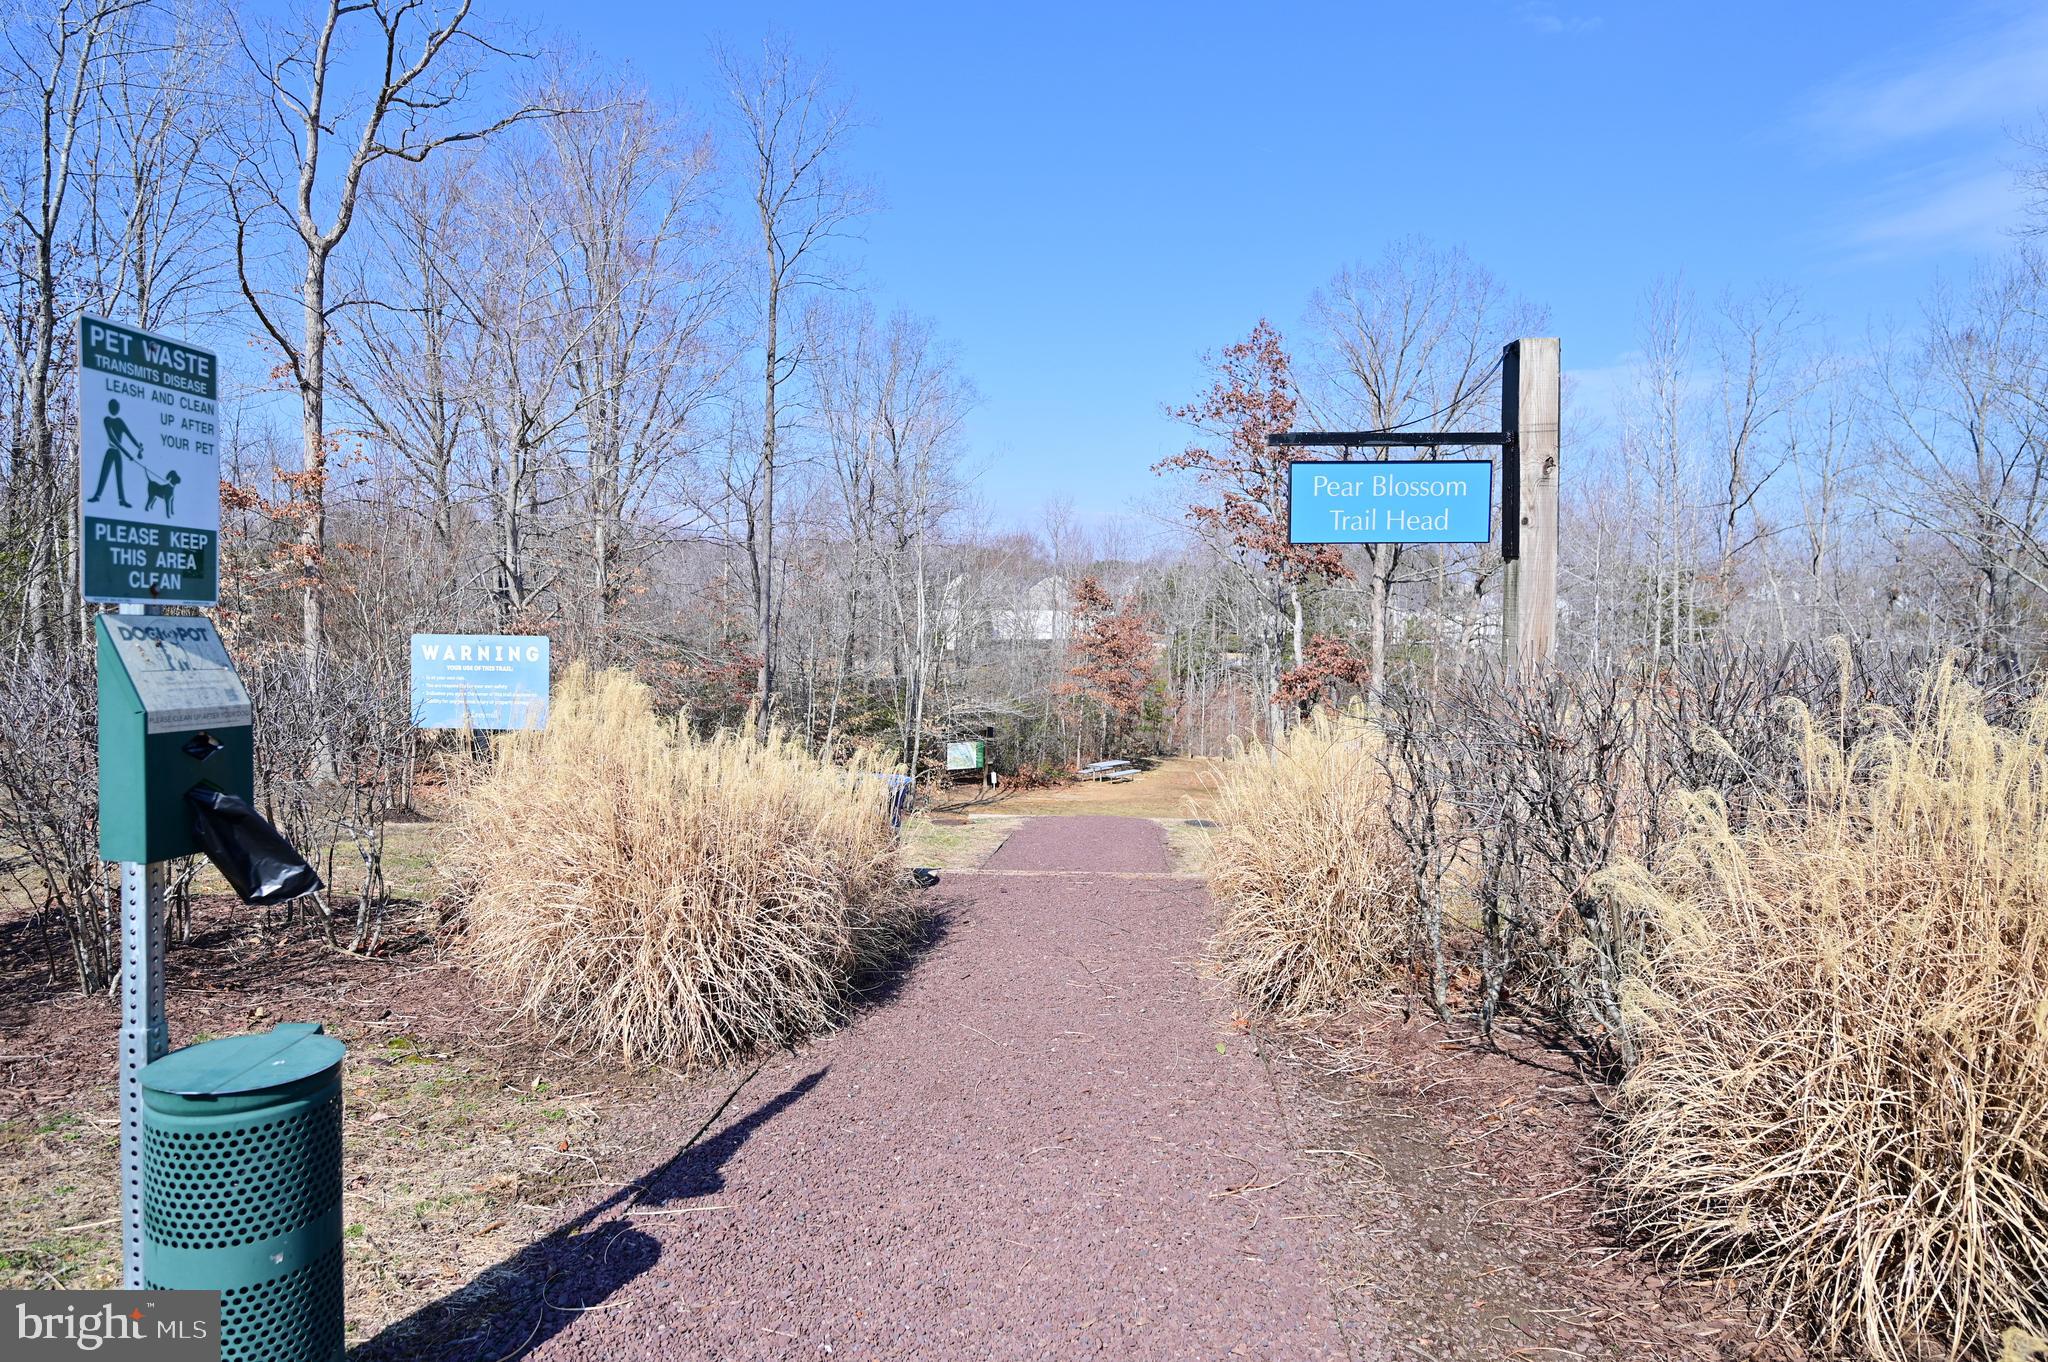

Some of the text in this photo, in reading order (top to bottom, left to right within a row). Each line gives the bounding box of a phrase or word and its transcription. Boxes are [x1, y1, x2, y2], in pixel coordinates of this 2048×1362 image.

[90, 325, 210, 378] PET WASTE
[94, 354, 207, 395] TRANSMITS DISEASE
[105, 378, 215, 416] LEASH AND CLEAN
[160, 412, 215, 436] UP AFTER
[160, 433, 215, 456] YOUR PET
[1313, 473, 1467, 497] Pear Blossom
[1329, 508, 1449, 531] Trail Head
[95, 523, 208, 550] PLEASE KEEP
[110, 547, 197, 570] THIS AREA
[128, 571, 181, 590] CLEAN
[421, 644, 540, 662] WARNING
